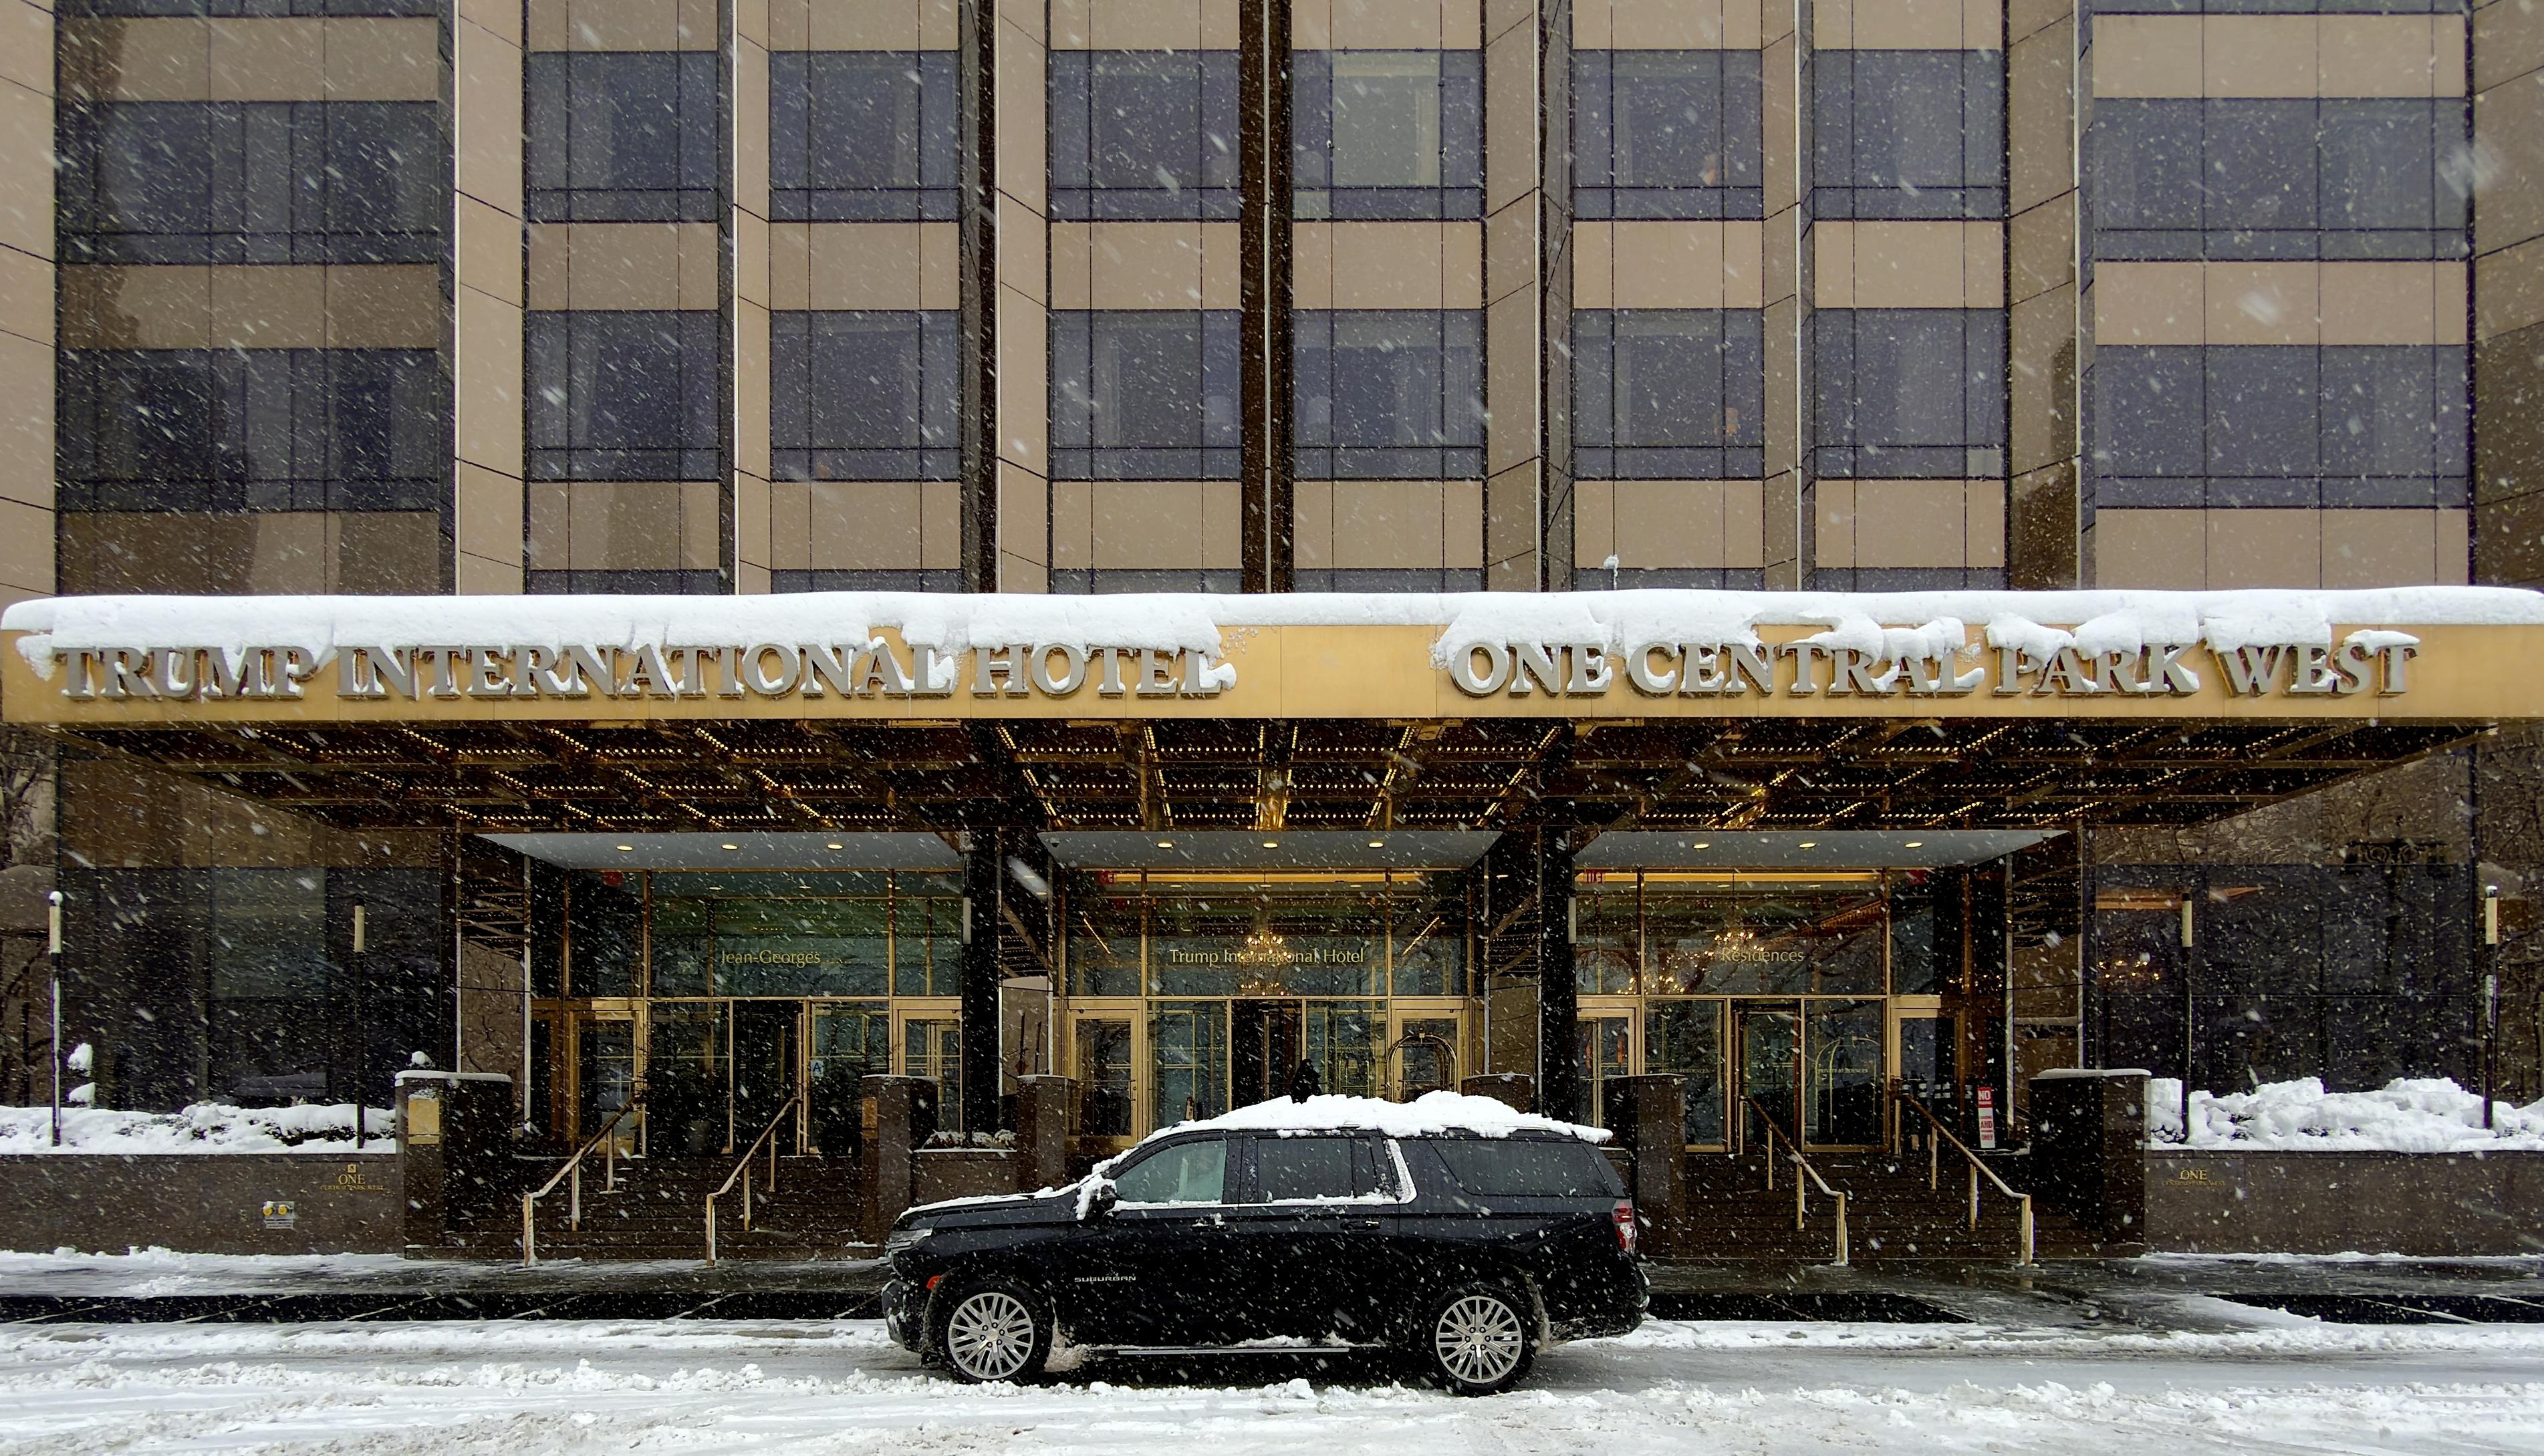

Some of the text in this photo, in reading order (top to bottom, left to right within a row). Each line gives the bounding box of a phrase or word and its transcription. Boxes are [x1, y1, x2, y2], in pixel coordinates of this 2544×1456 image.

[52, 643, 1227, 700] TRUMP INTERNATIONAL HOTEL
[1451, 642, 2421, 698] ONE CENTRAL PARK WEST
[721, 950, 821, 968] Jean-Georges
[1169, 949, 1219, 967] Trump
[1323, 948, 1364, 963] Hotel
[1721, 947, 1805, 962] Residences
[813, 1062, 821, 1072] A
[1979, 1090, 1991, 1101] NO
[338, 1173, 366, 1185] ONE
[2180, 1169, 2208, 1180] ONE
